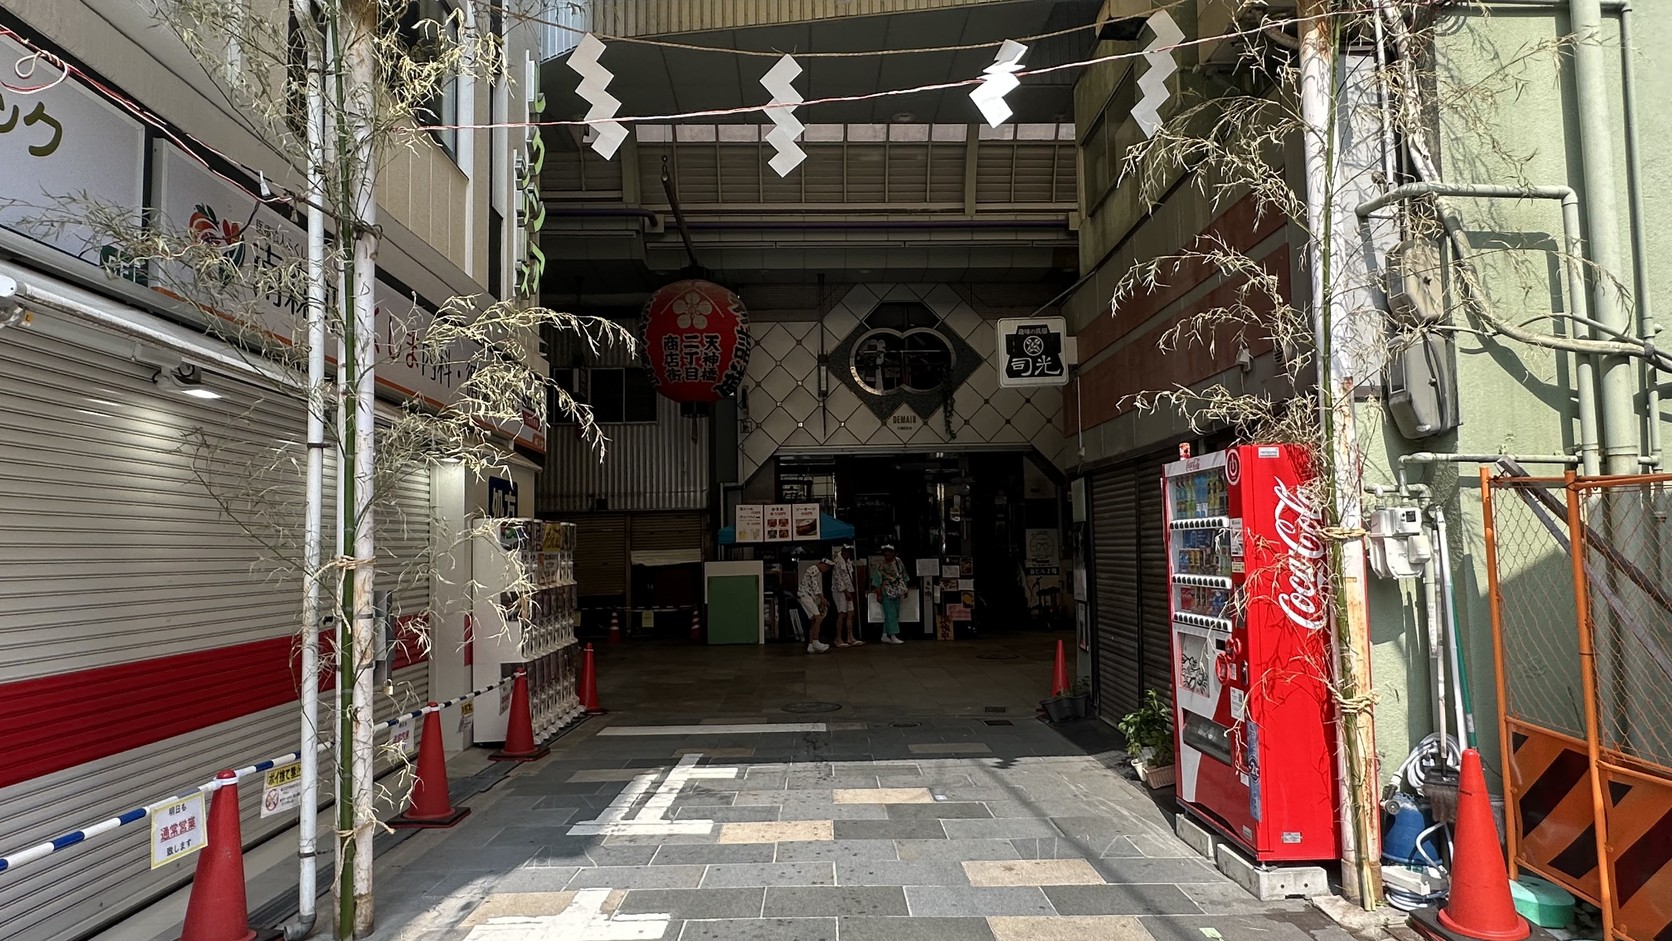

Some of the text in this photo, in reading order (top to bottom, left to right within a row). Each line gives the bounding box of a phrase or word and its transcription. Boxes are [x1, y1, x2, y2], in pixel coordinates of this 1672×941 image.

[664, 334, 682, 382] 商店街
[683, 334, 701, 382] 二丁目
[701, 334, 721, 382] 天神橋
[169, 803, 187, 816] 明日も
[160, 816, 196, 841] 通常営業
[167, 838, 192, 856] 致します
